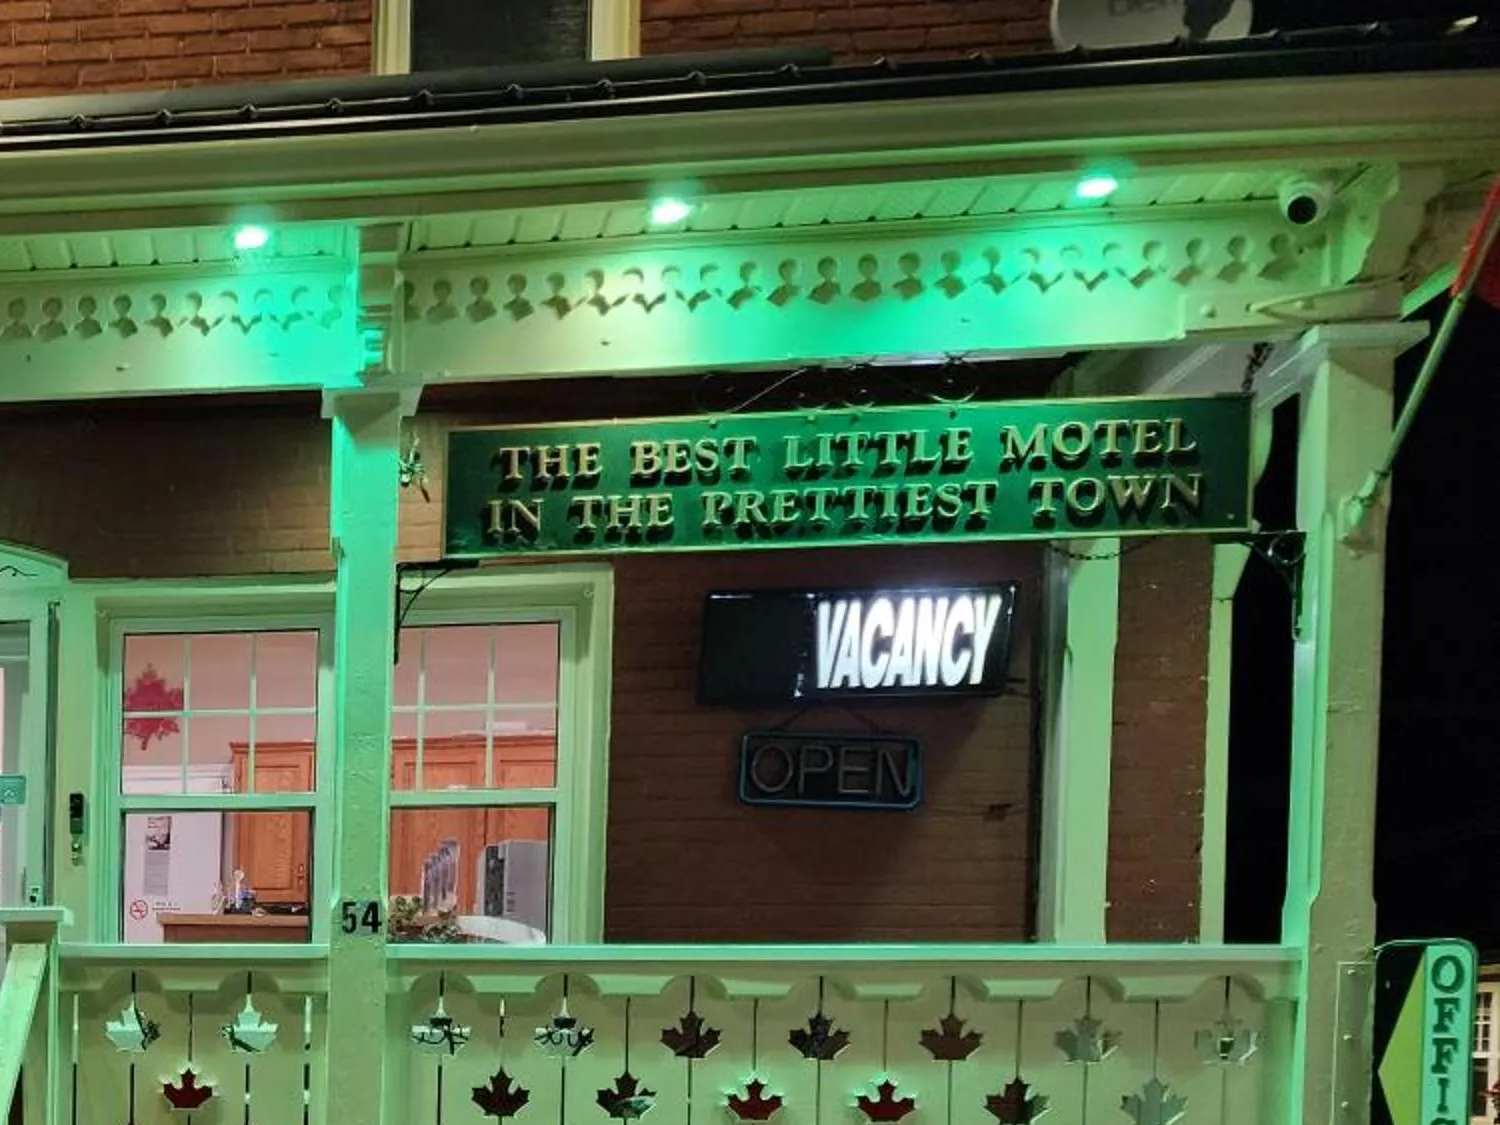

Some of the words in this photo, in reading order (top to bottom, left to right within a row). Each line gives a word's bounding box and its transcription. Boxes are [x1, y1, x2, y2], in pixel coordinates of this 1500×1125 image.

[498, 442, 604, 480] THE
[630, 435, 757, 477] BEST
[783, 426, 975, 470] LITTLE
[1001, 417, 1198, 461] MOTEL
[486, 497, 545, 535] IN
[571, 493, 675, 530] THE
[701, 479, 1000, 528] PRETTIEST
[1028, 471, 1204, 519] TOWN
[816, 594, 1003, 690] VACANCY
[750, 743, 913, 798] OPEN
[341, 901, 383, 935] 54
